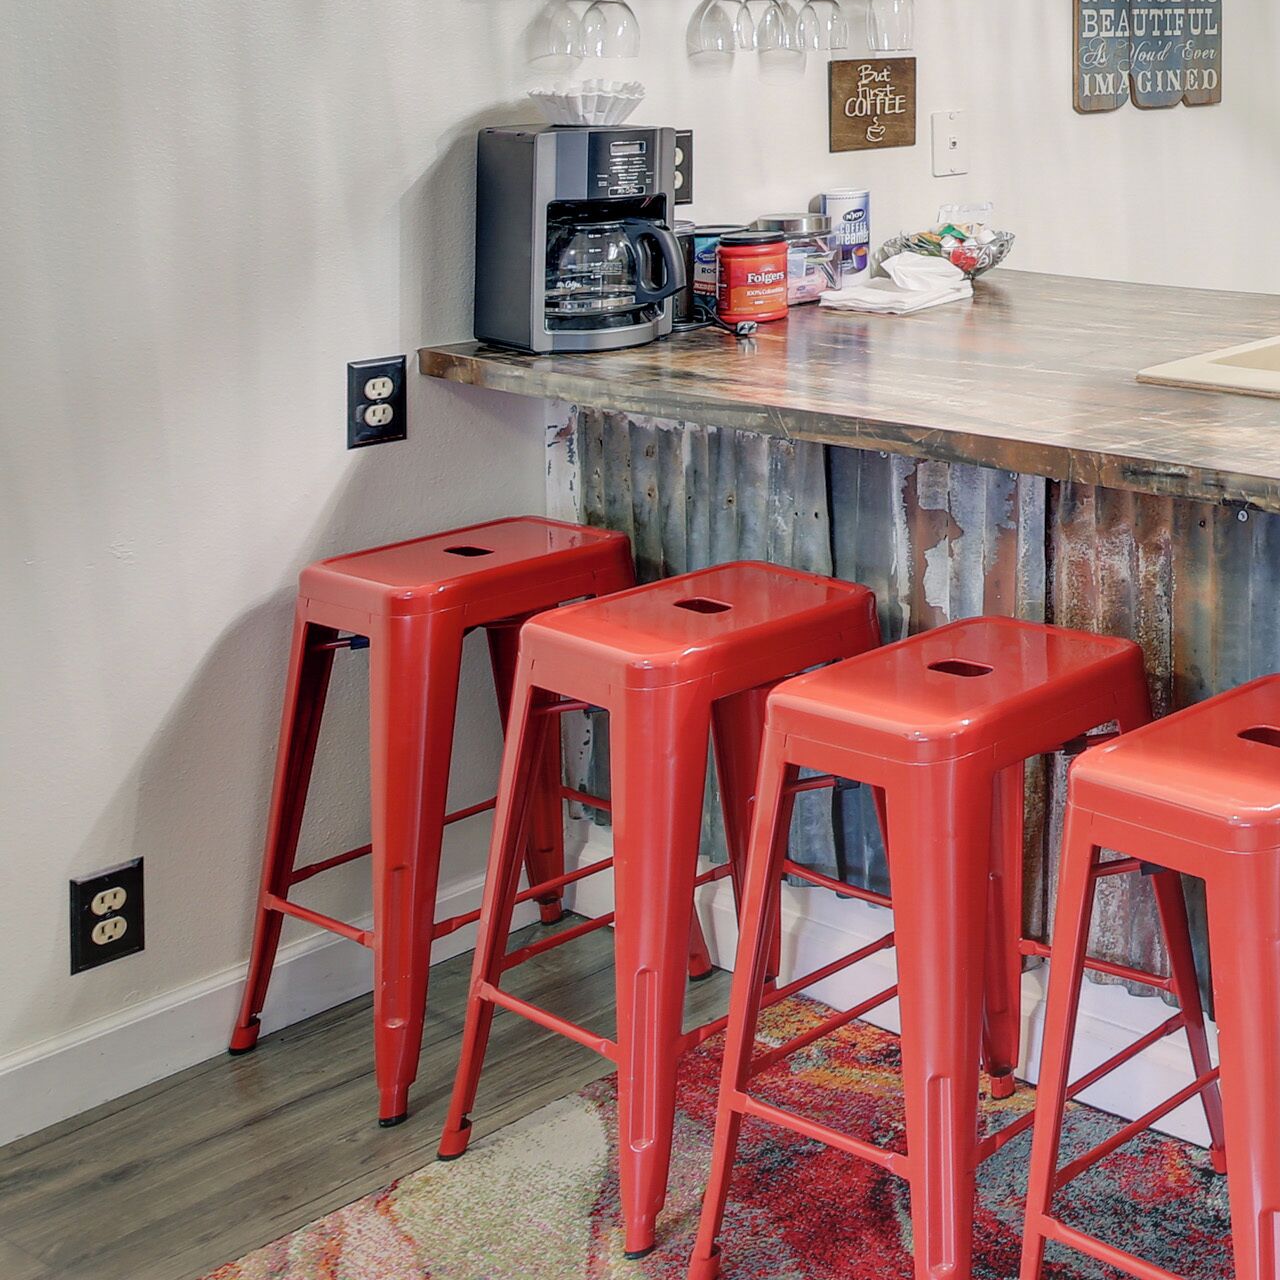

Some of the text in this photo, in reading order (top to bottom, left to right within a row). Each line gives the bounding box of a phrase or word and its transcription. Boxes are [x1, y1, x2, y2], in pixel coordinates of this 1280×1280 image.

[1081, 8, 1219, 39] BEAUTIFUL
[1079, 37, 1217, 72] As You'd Ever
[857, 64, 891, 83] But
[1082, 69, 1217, 97] IMAGINED
[845, 95, 906, 117] COFFEE
[840, 222, 867, 233] COFFEE
[747, 271, 785, 284] Folgers
